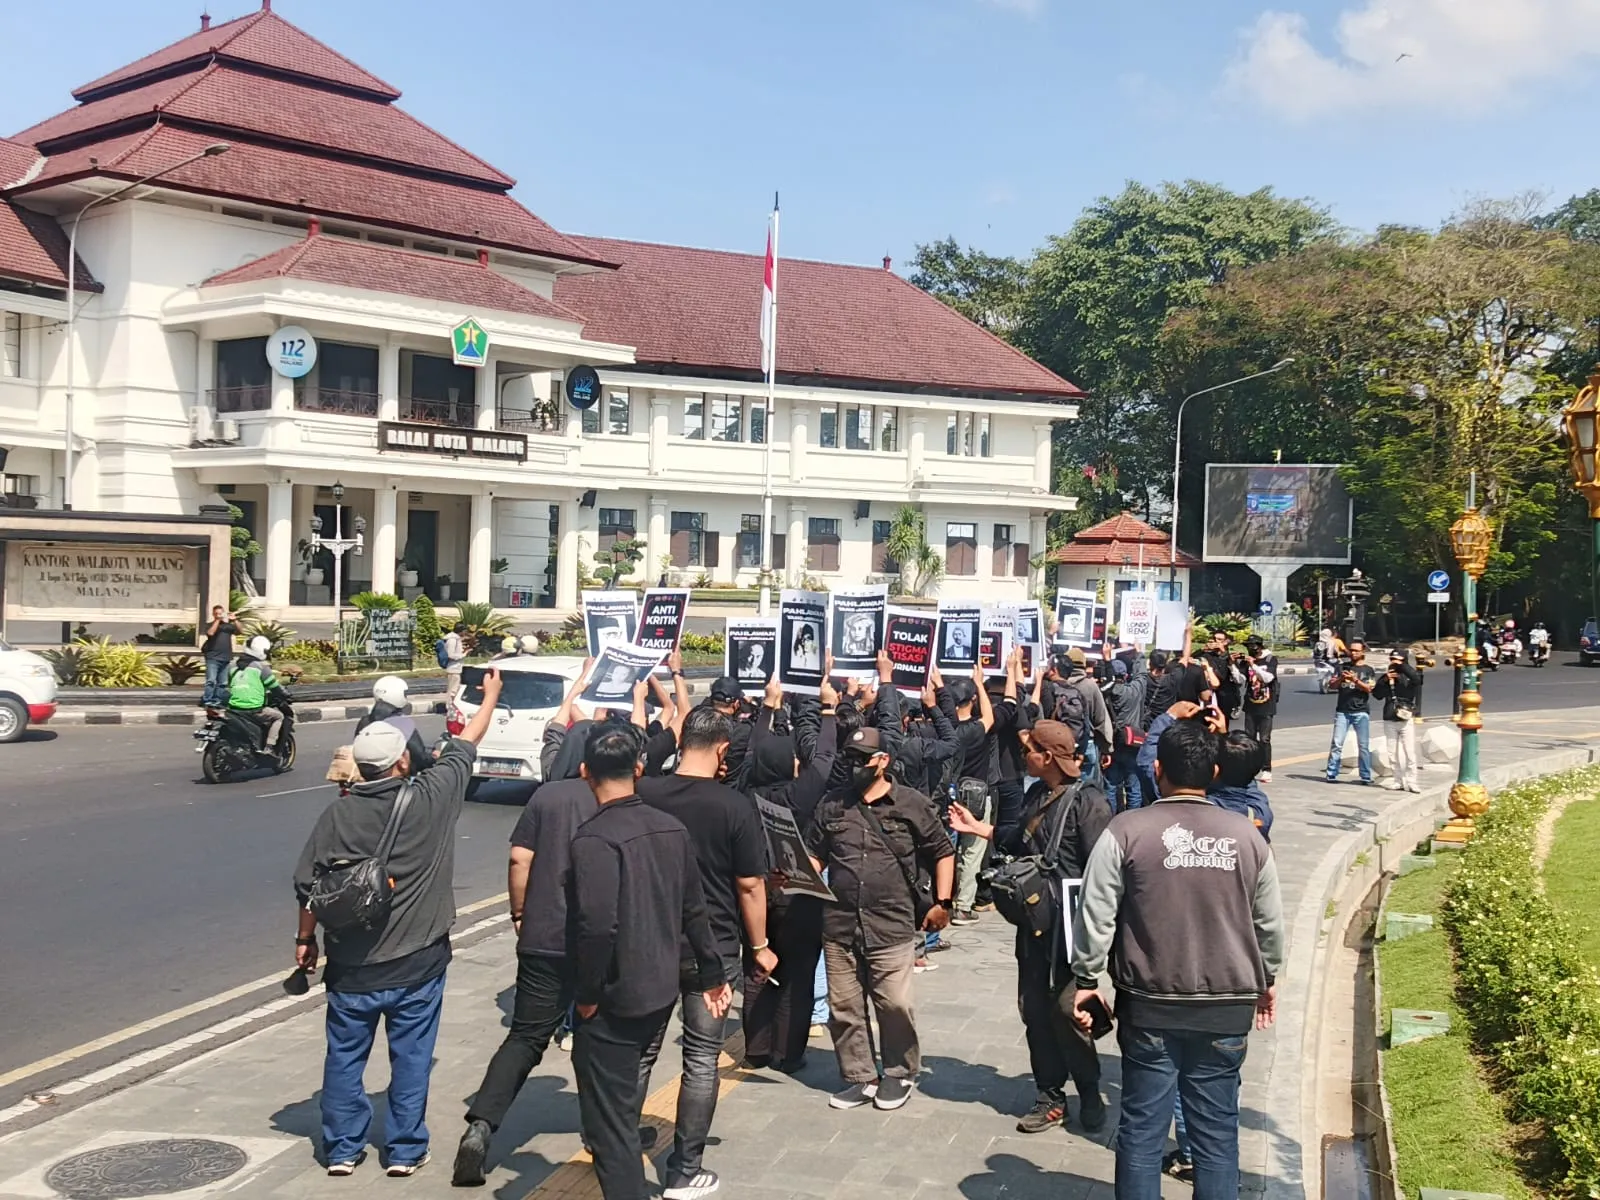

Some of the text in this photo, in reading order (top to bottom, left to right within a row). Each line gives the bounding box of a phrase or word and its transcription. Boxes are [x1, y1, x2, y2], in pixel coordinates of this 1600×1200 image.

[282, 339, 305, 357] 112
[574, 376, 594, 393] 112
[24, 554, 184, 571] KANTOR WALIKOTA MALANG
[77, 587, 130, 598] MALANG
[652, 605, 677, 615] ANTI
[1129, 609, 1149, 618] HAK
[646, 615, 679, 626] KRITIK
[893, 630, 928, 643] TOLAK
[641, 638, 675, 649] TAKUT
[889, 643, 928, 654] STIGMA
[892, 651, 923, 662] TISASI
[892, 663, 925, 673] URNALIS
